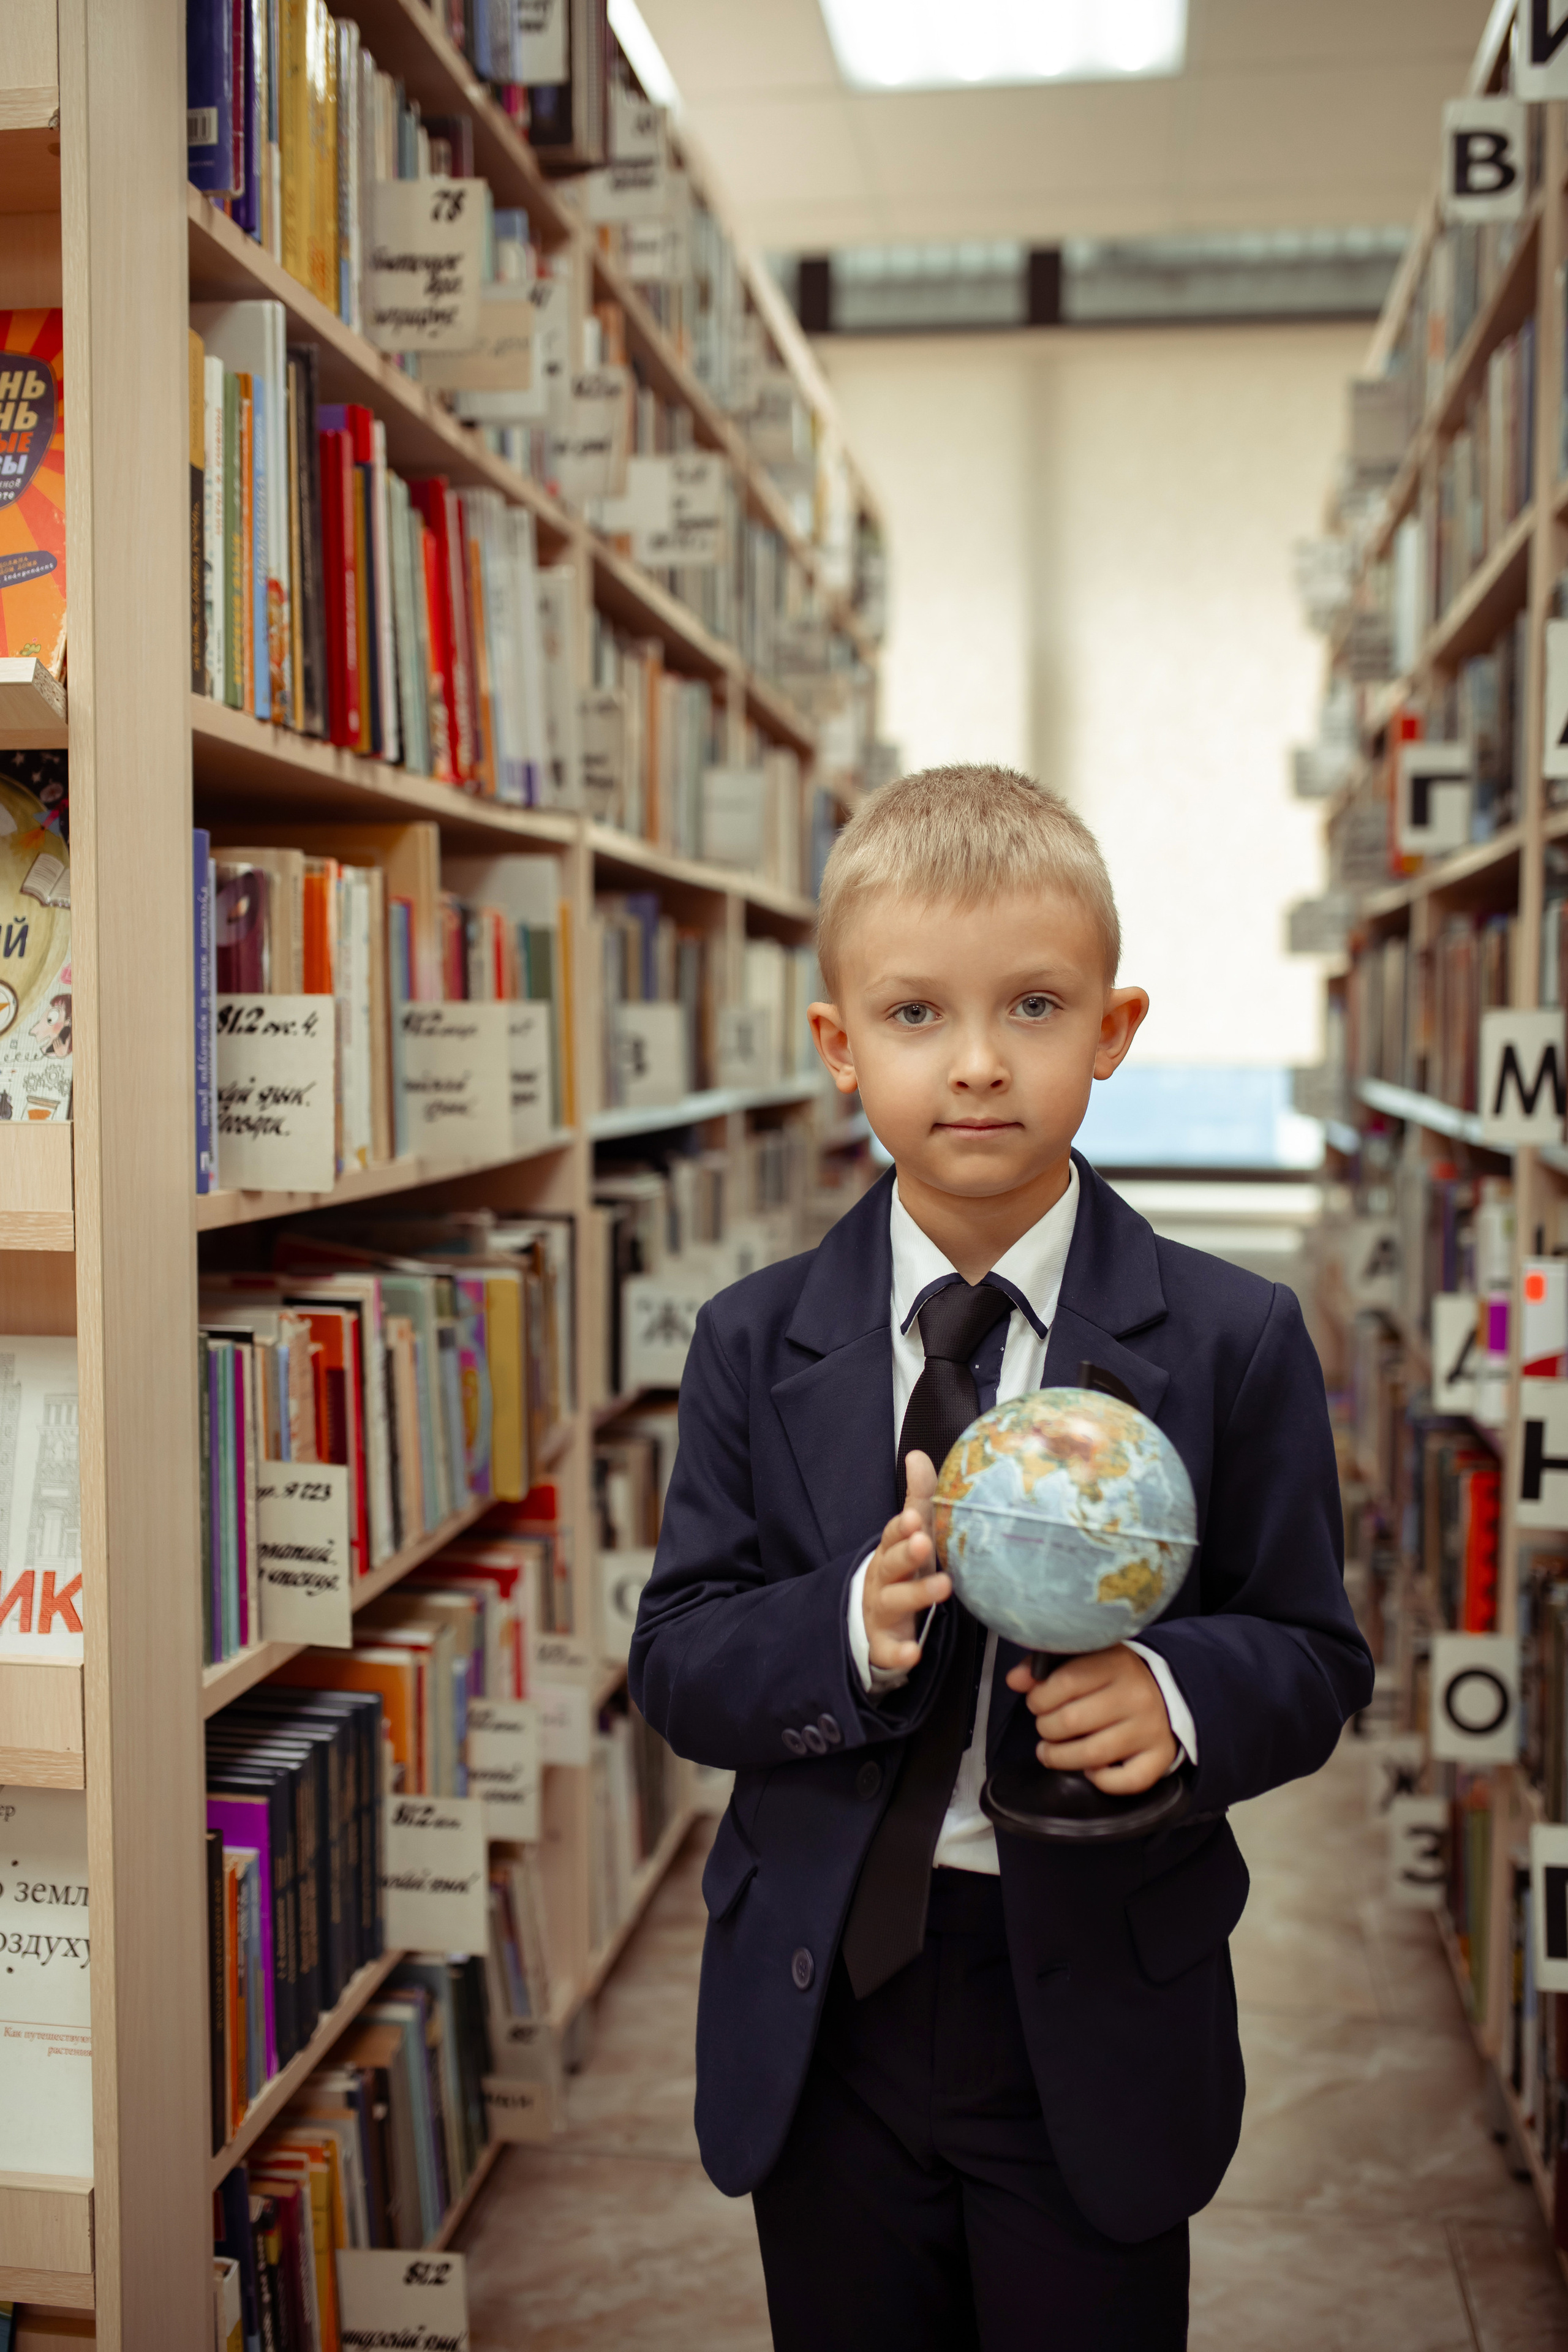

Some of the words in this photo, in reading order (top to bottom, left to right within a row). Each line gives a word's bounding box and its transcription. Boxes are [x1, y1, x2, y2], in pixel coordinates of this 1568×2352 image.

[1455, 132, 1516, 195] В
[0, 454, 28, 476] Ы
[4, 562, 53, 581] Independent
[0, 916, 29, 959] Й
[1494, 1045, 1566, 1114] М
[0, 1569, 84, 1634] ИК
[1444, 1668, 1509, 1734] О
[4, 2026, 21, 2038] Как
